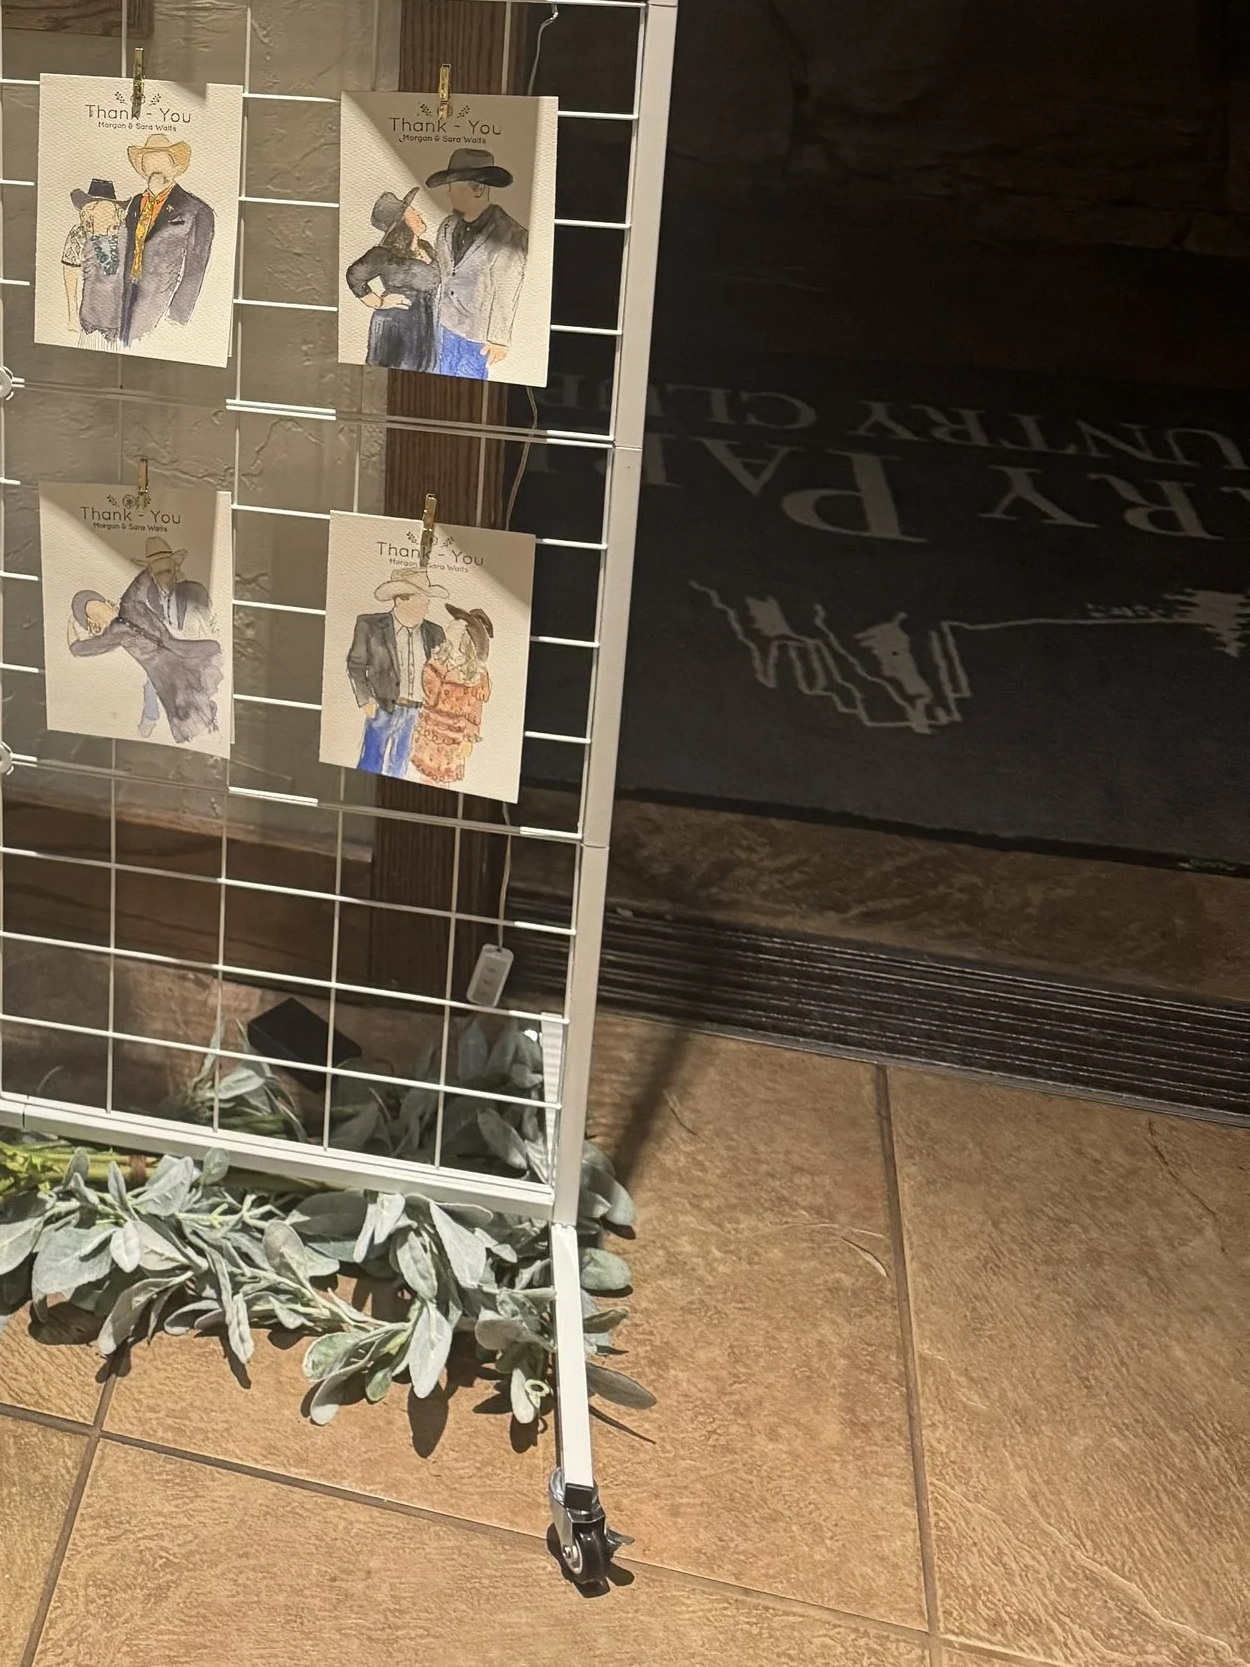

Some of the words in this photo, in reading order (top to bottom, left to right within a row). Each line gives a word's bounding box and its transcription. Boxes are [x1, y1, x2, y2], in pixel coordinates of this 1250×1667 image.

[85, 104, 139, 121] Thank
[159, 107, 191, 124] You
[98, 121, 126, 130] Morgan
[135, 122, 154, 131] Sara
[388, 117, 447, 133] Thank
[468, 120, 501, 136] You
[402, 134, 433, 143] Morgan
[442, 135, 461, 143] Sara
[979, 464, 1250, 544] RY
[80, 506, 132, 522] Thank
[150, 509, 181, 525] You
[93, 521, 120, 531] Morgan
[128, 523, 146, 532] Sara
[376, 541, 430, 560] Thank
[451, 549, 484, 567] You
[389, 557, 418, 568] Morgan
